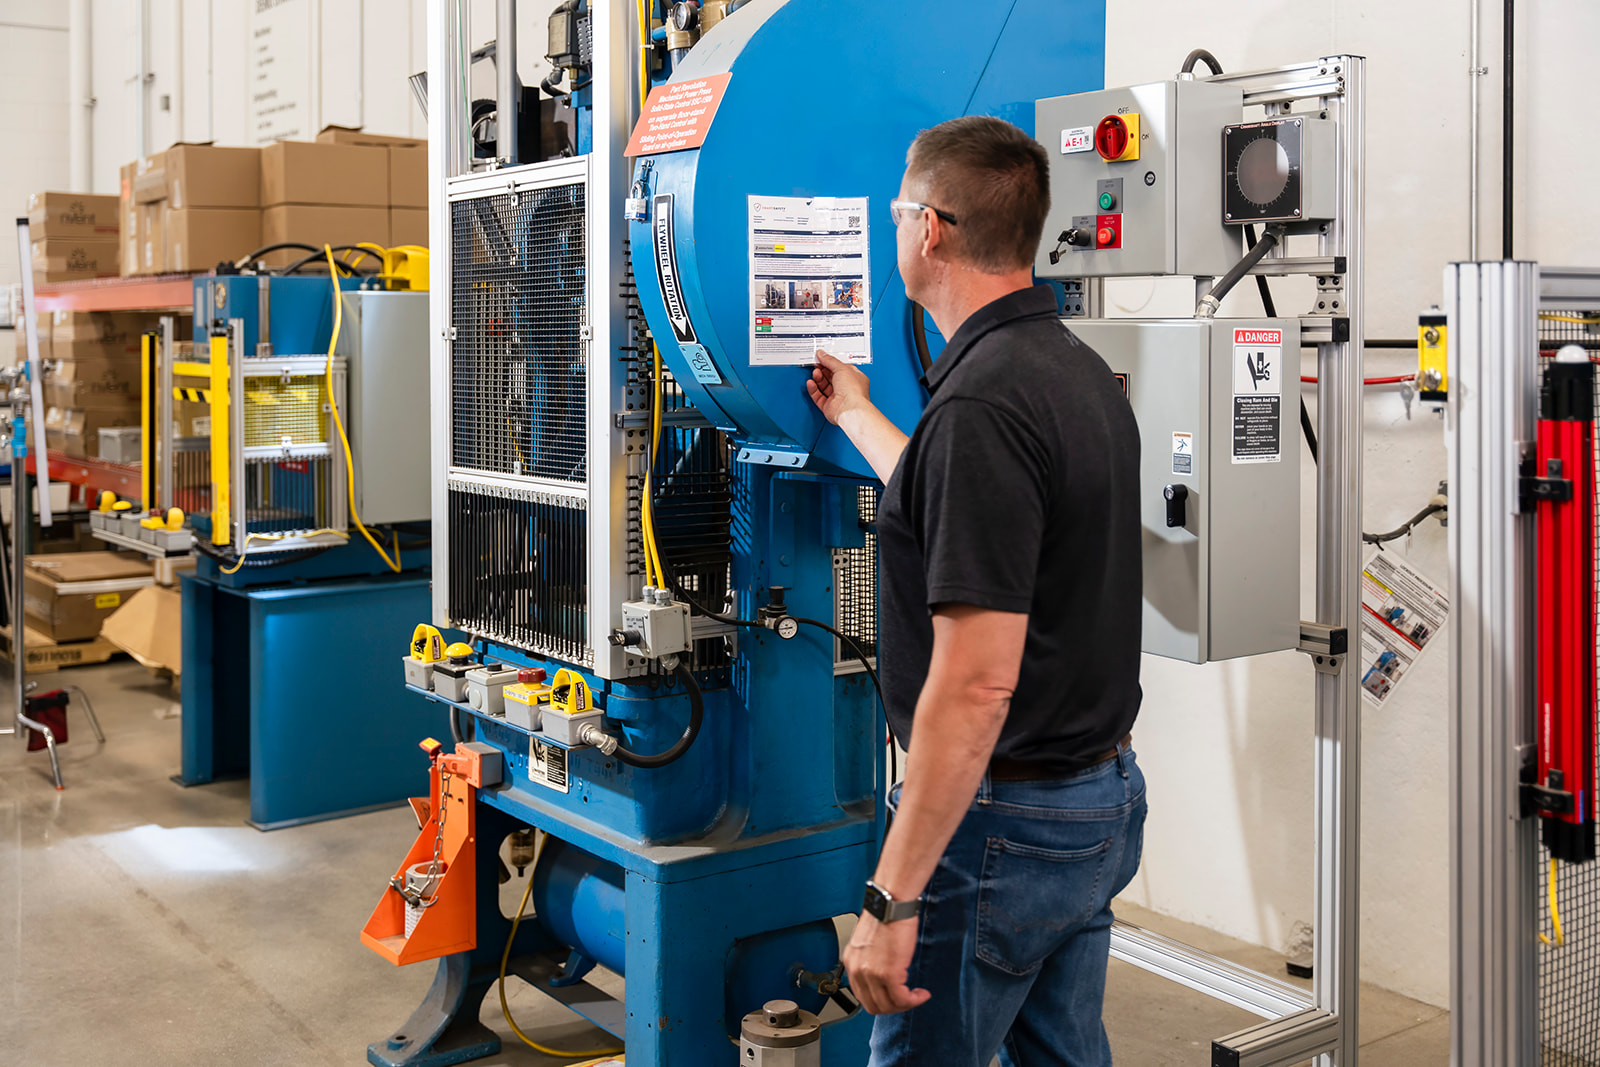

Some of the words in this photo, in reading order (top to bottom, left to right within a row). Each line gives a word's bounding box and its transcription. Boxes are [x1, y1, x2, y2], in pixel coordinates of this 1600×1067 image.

[670, 85, 680, 94] Part
[681, 81, 707, 91] Revolution
[658, 93, 683, 103] Mechanical
[683, 90, 698, 99] Power
[674, 99, 690, 109] Control
[649, 122, 670, 132] Two-Hand
[670, 119, 688, 128] Control
[1072, 136, 1083, 147] E-1
[658, 218, 671, 271] FLYWHEEL
[664, 274, 682, 321] ROTATION
[1245, 332, 1279, 343] DANGER
